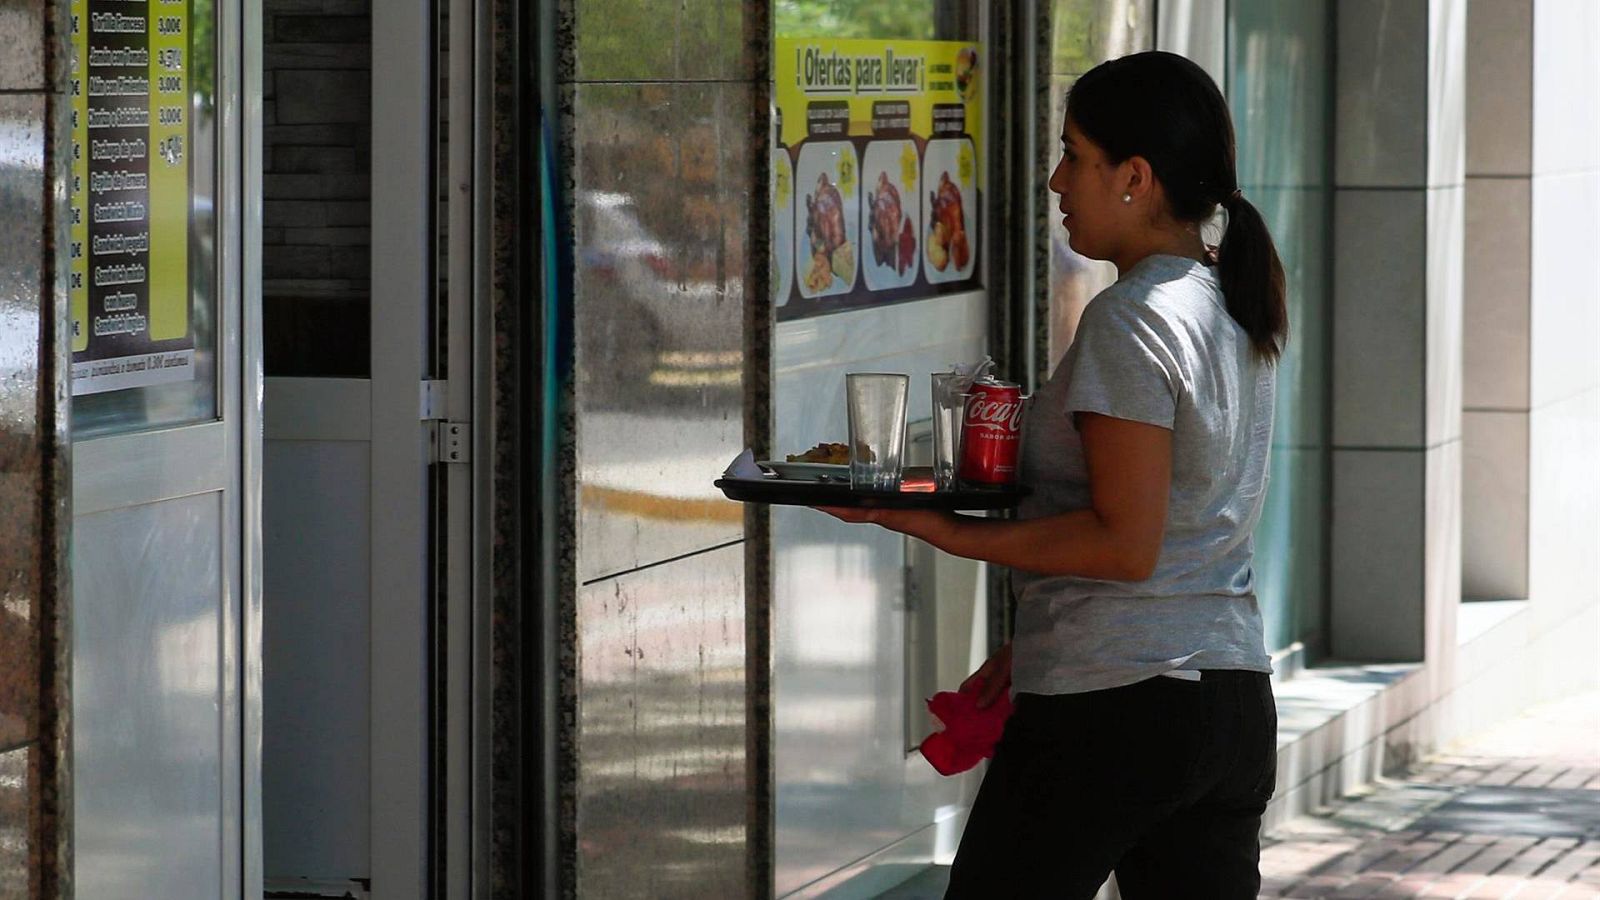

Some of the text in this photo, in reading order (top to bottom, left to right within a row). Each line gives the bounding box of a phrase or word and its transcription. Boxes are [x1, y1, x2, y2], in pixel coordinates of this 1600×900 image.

[804, 47, 852, 87] Ofertas
[855, 56, 882, 94] para
[94, 203, 126, 223] Sandwich
[93, 235, 125, 255] Sandwich
[95, 265, 127, 286] Sandwich
[94, 315, 126, 336] Sandwich
